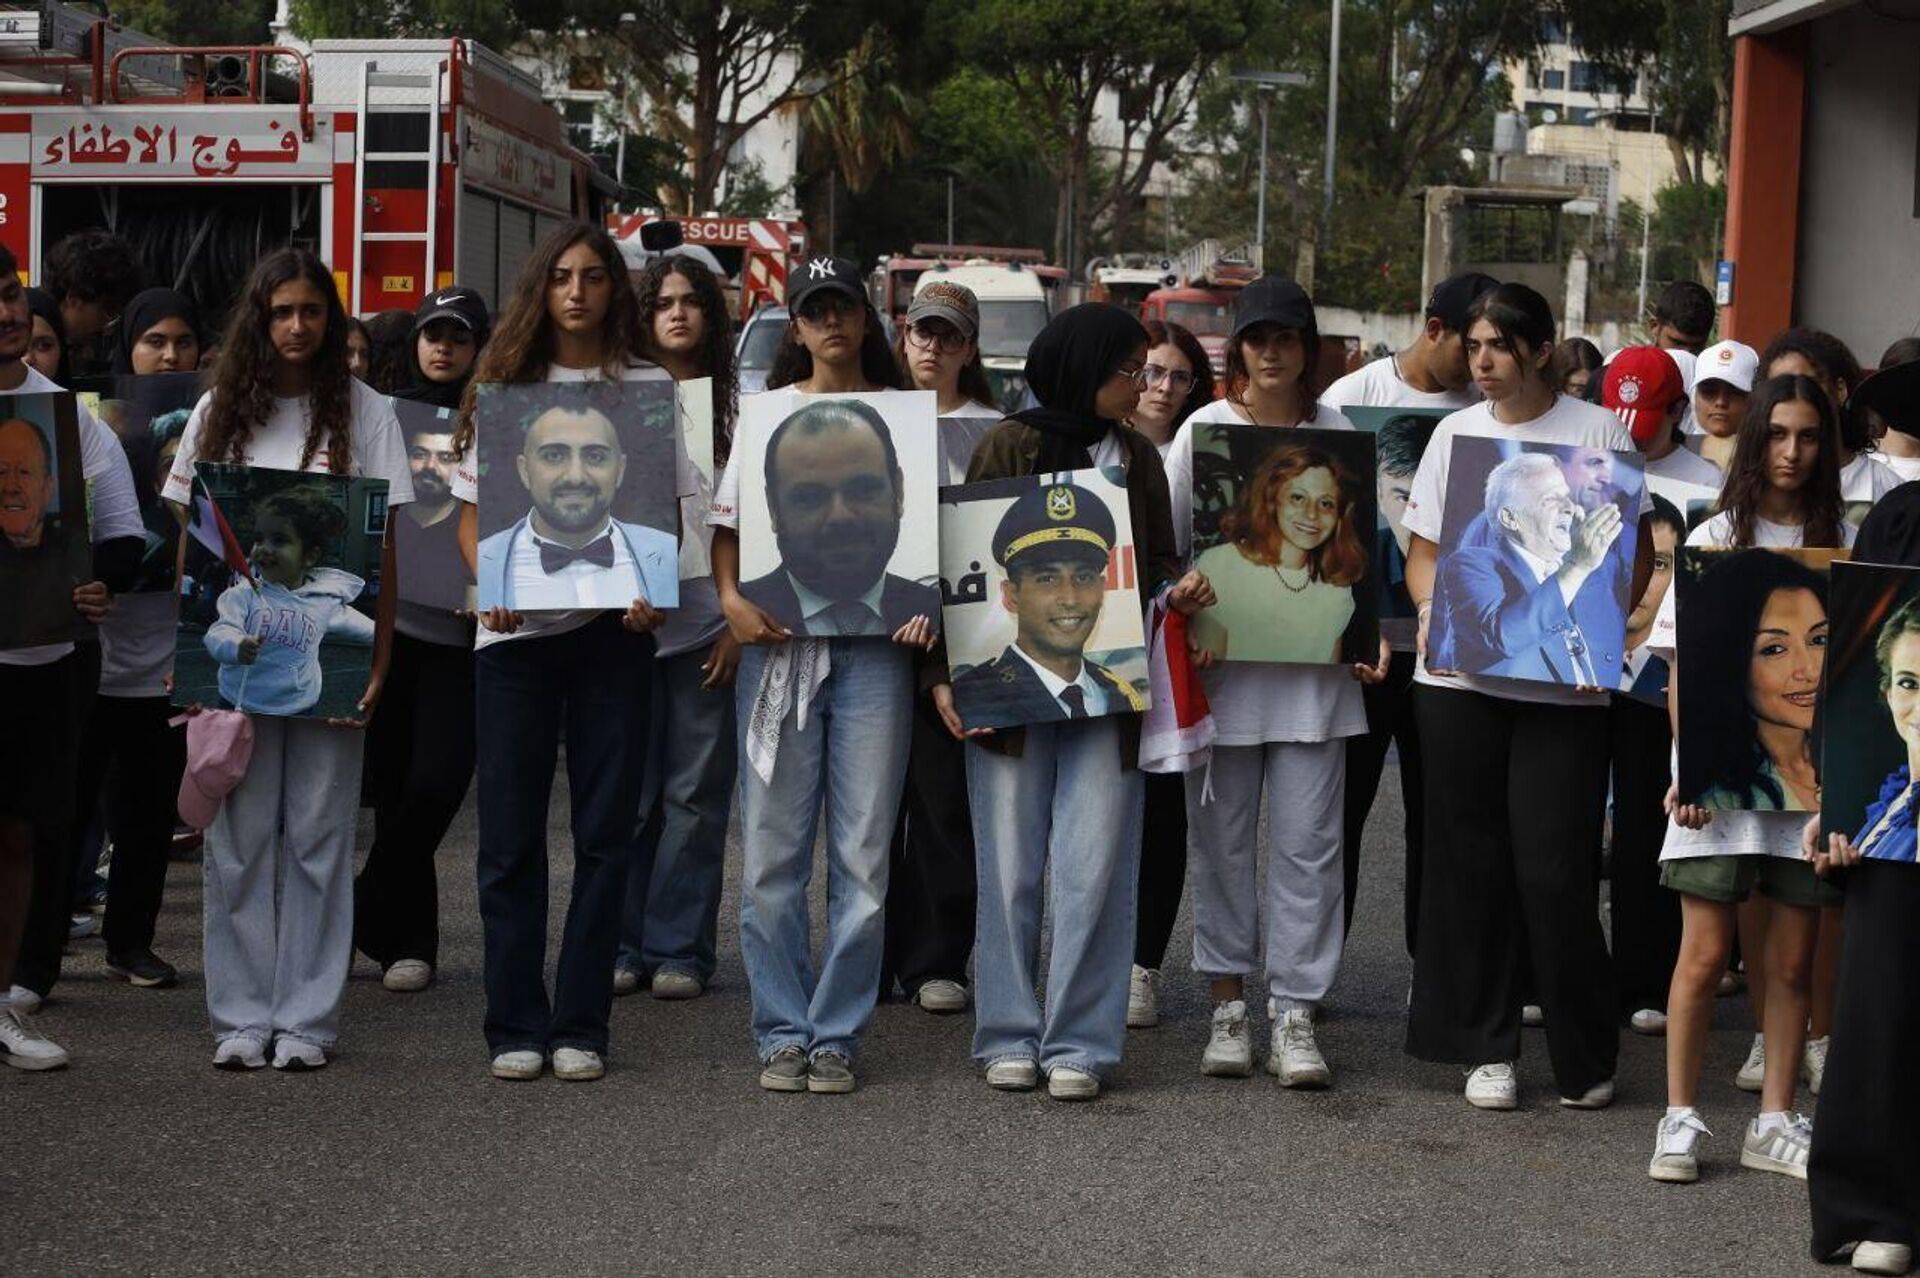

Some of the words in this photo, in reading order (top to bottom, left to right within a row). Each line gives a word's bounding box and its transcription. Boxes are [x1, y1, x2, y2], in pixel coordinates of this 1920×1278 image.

[193, 120, 299, 175] فوج
[680, 221, 749, 241] ESCUE
[809, 257, 836, 280] NY
[245, 607, 318, 653] GAP
